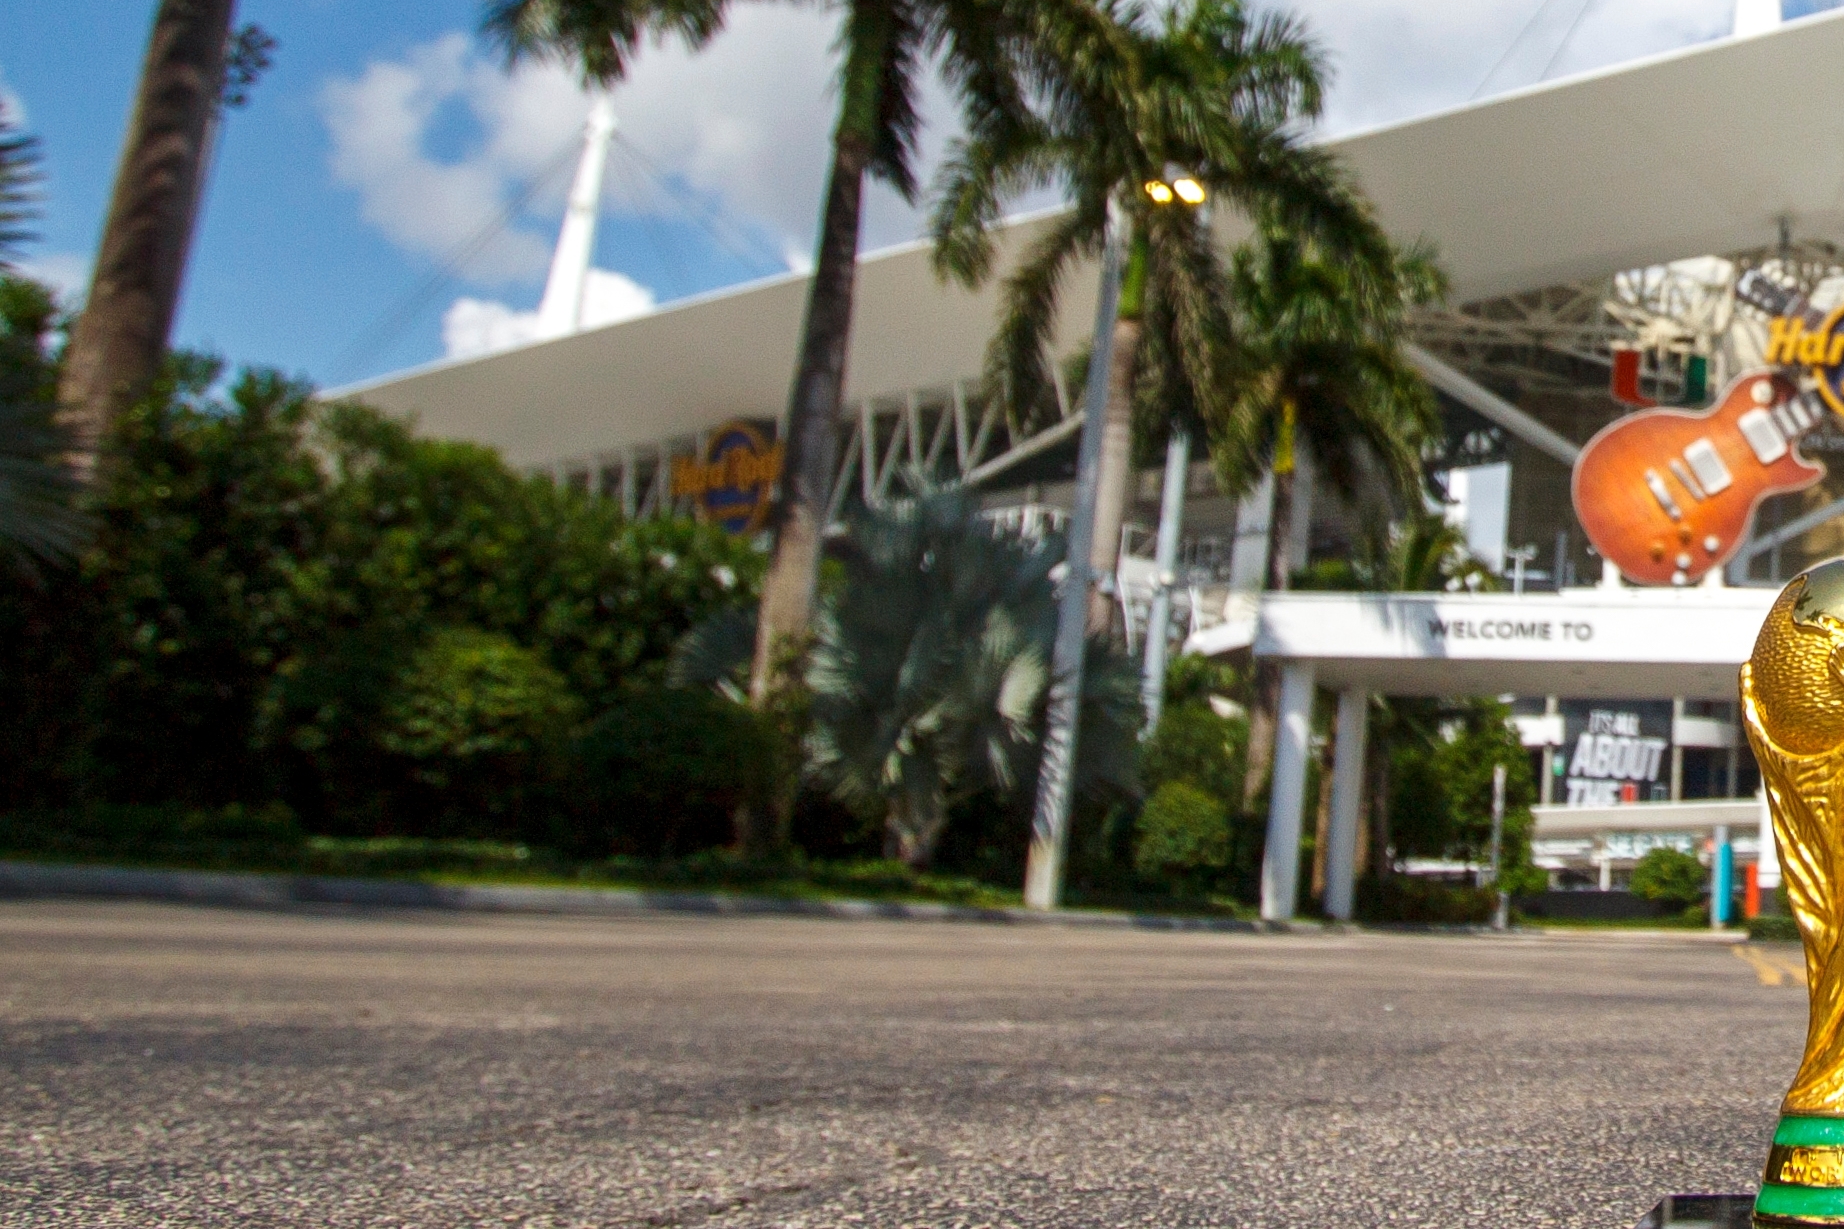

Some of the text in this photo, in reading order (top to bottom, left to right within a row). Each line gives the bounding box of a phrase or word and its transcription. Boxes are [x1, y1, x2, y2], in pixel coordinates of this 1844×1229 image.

[1428, 620, 1593, 641] WELCOME TO
[1612, 711, 1640, 737] ALL
[1568, 732, 1668, 783] ABOUT
[1566, 777, 1621, 807] THE
